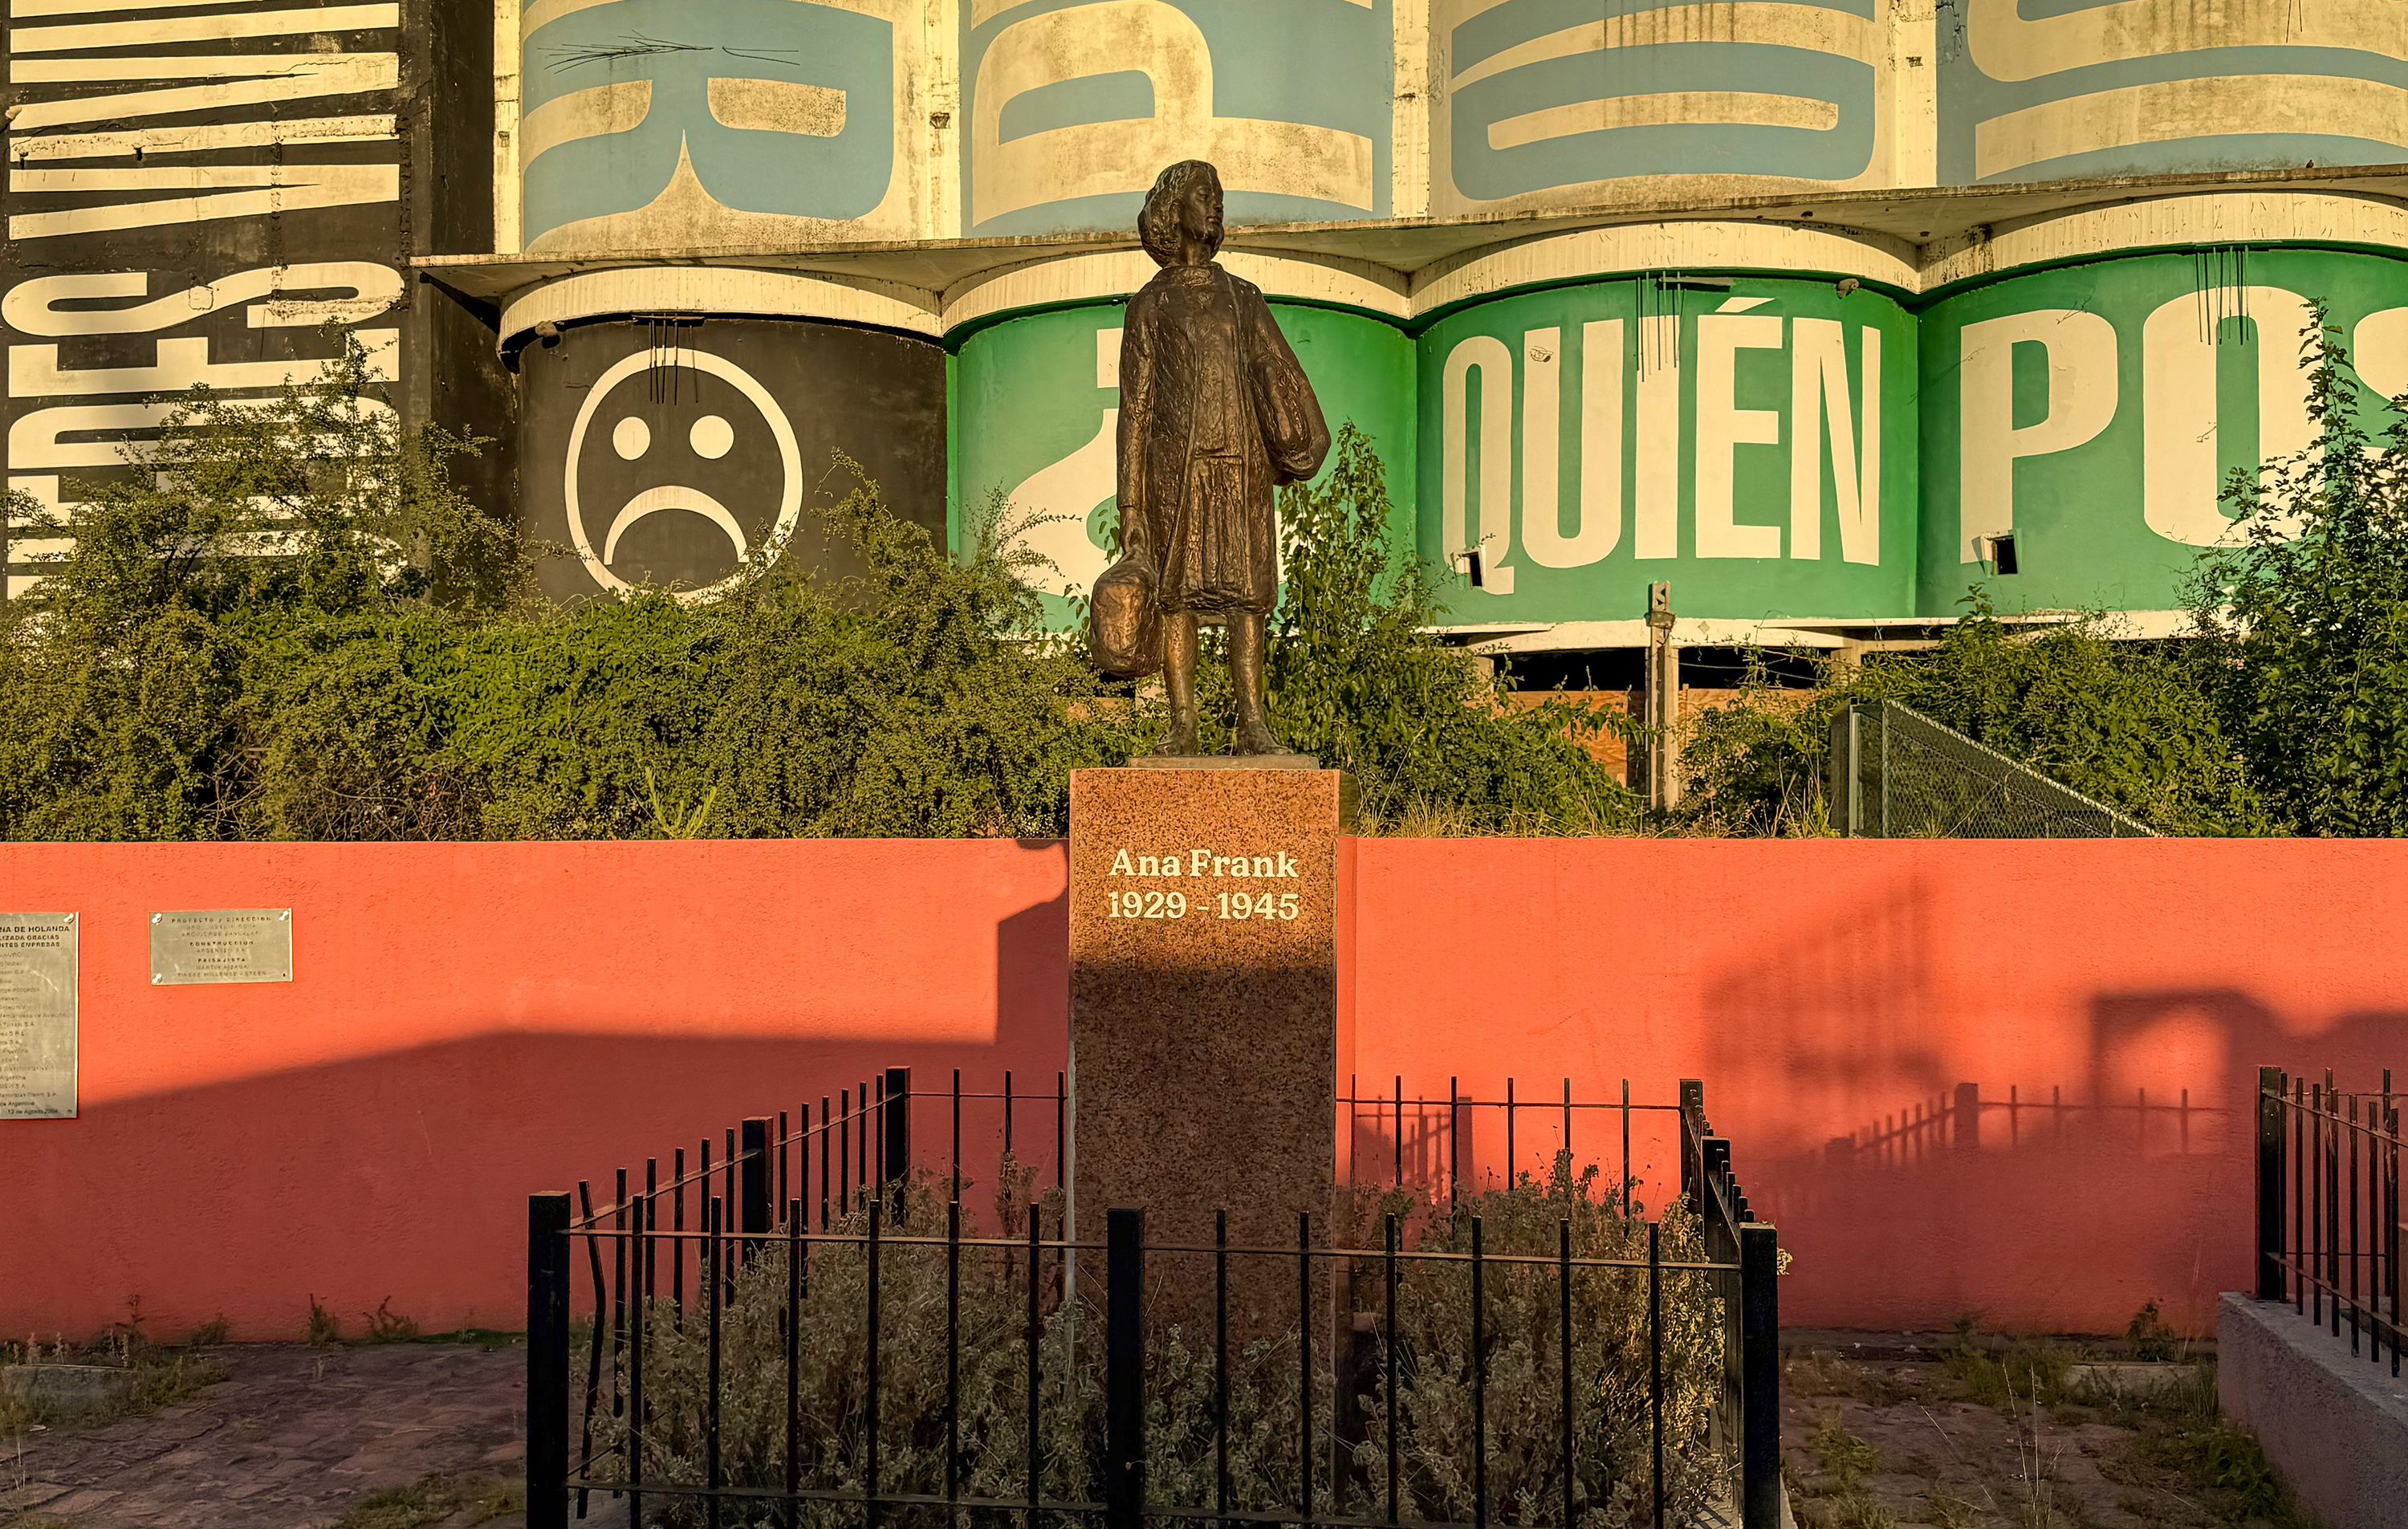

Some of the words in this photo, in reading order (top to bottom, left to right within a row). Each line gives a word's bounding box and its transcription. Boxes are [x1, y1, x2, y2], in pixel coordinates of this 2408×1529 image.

[1442, 297, 1881, 595] QUIÉN
[1108, 848, 1182, 876] Ana
[1189, 848, 1300, 878] Frank
[1108, 891, 1187, 919] 1929
[1218, 893, 1300, 921] 1945
